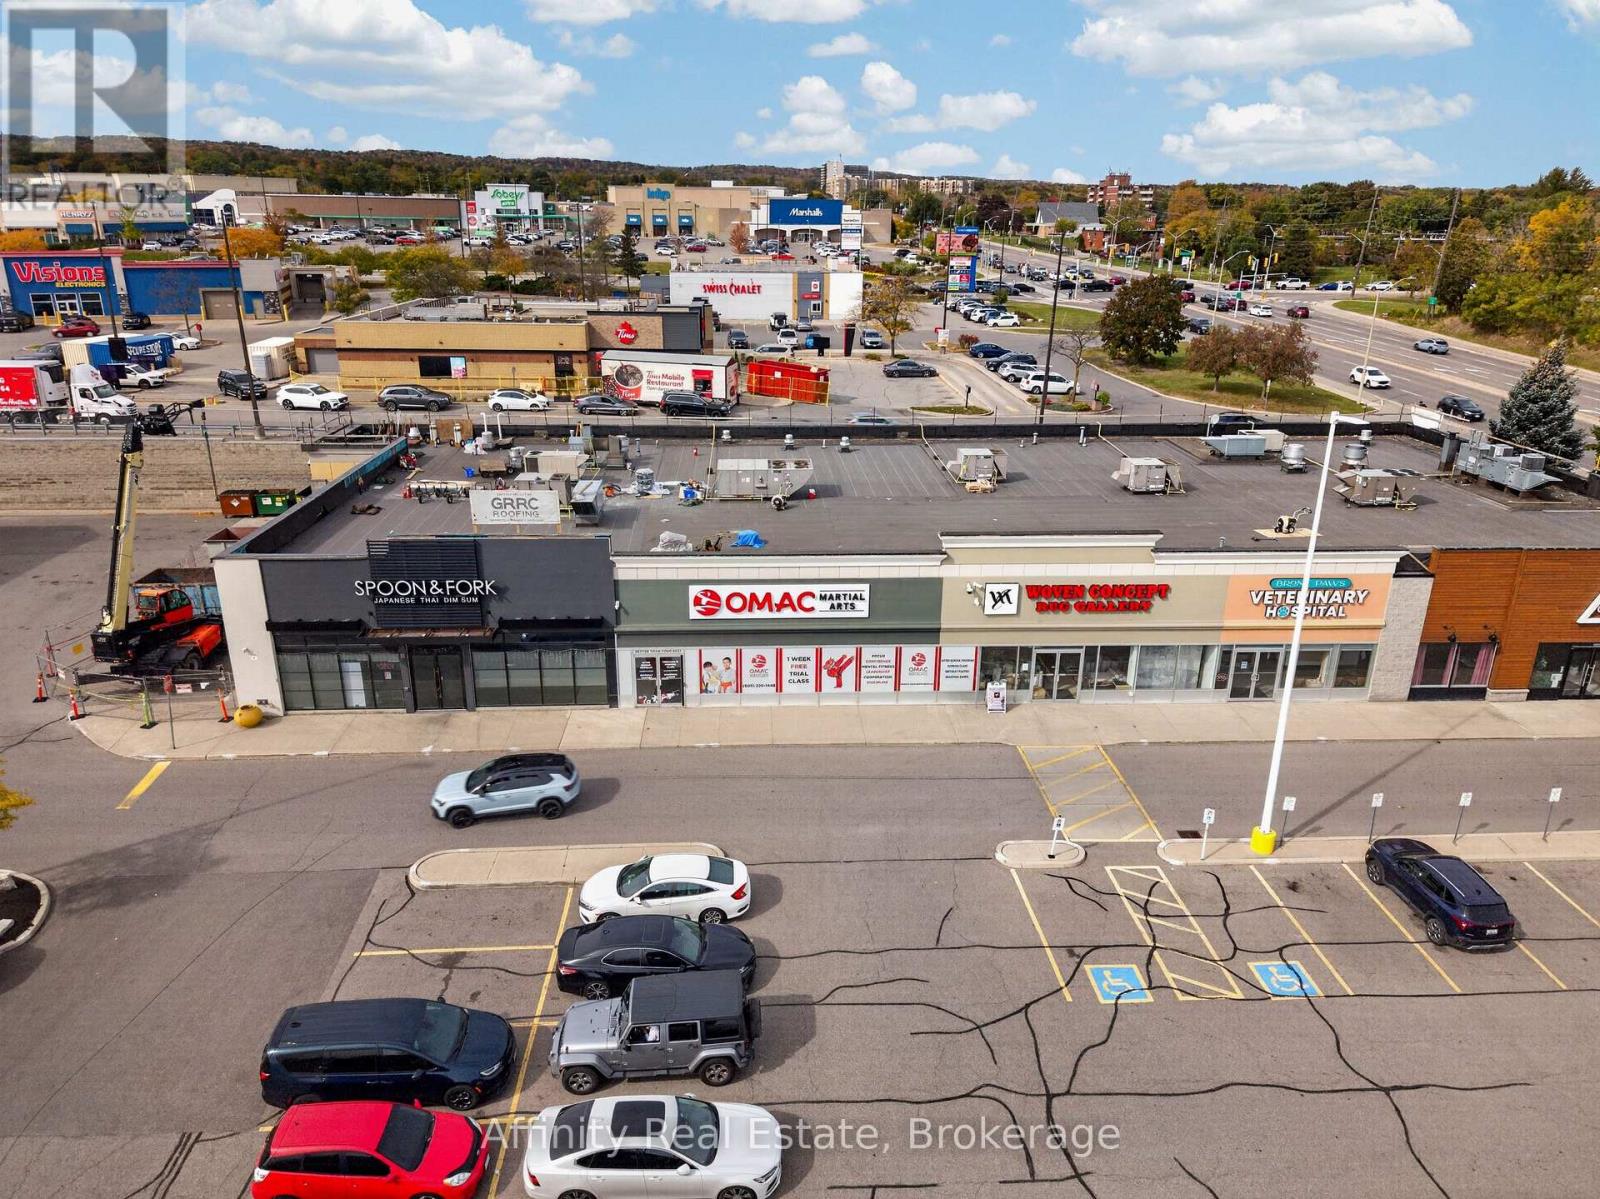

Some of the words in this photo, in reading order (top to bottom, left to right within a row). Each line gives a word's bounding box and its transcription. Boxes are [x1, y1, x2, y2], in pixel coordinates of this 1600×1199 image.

[491, 189, 525, 199] Sobeys
[789, 208, 823, 217] Marshalls
[12, 262, 105, 282] Visions
[703, 284, 727, 293] SWISS
[729, 283, 762, 296] CHALET
[662, 373, 685, 381] Mobile
[647, 379, 684, 387] Restaurant
[491, 497, 539, 510] GRRC
[819, 593, 865, 601] MARTIAL
[1025, 584, 1085, 600] WOVEN
[1088, 584, 1171, 600] CONCEPT
[725, 591, 816, 613] OMAC
[829, 602, 856, 610] ARTS
[1073, 601, 1153, 613] GALLERY
